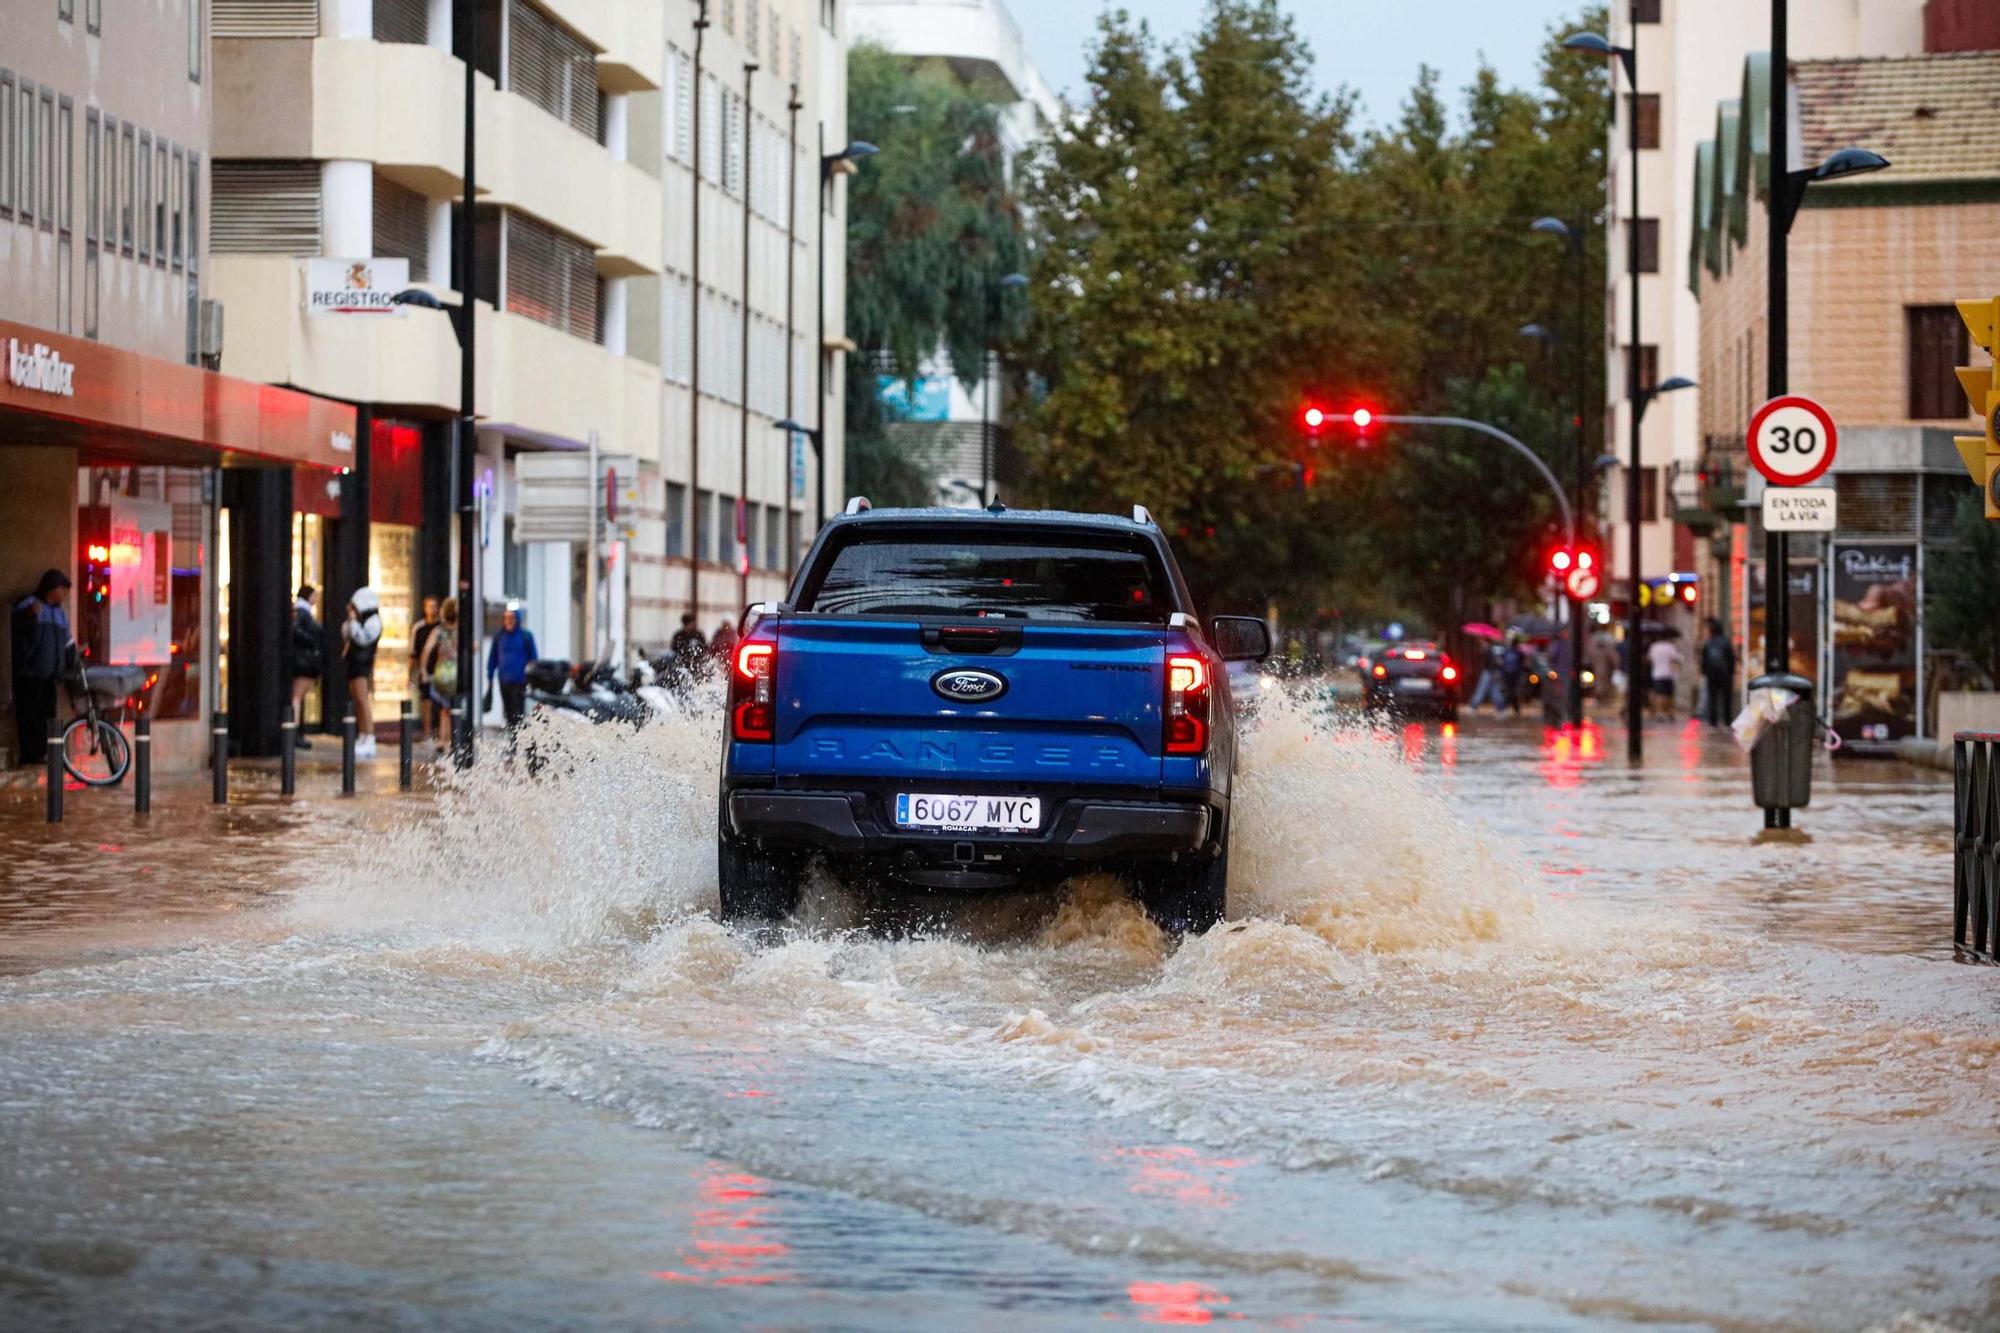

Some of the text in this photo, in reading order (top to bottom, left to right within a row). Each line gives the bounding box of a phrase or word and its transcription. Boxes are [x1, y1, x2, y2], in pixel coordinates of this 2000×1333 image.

[313, 291, 400, 306] REGISTRO
[1770, 426, 1816, 455] 30
[1772, 498, 1827, 509] EN TODA
[1779, 511, 1796, 521] LA
[951, 676, 987, 693] Ford
[809, 737, 1125, 768] RANGER
[914, 798, 1034, 824] 6067 MYC
